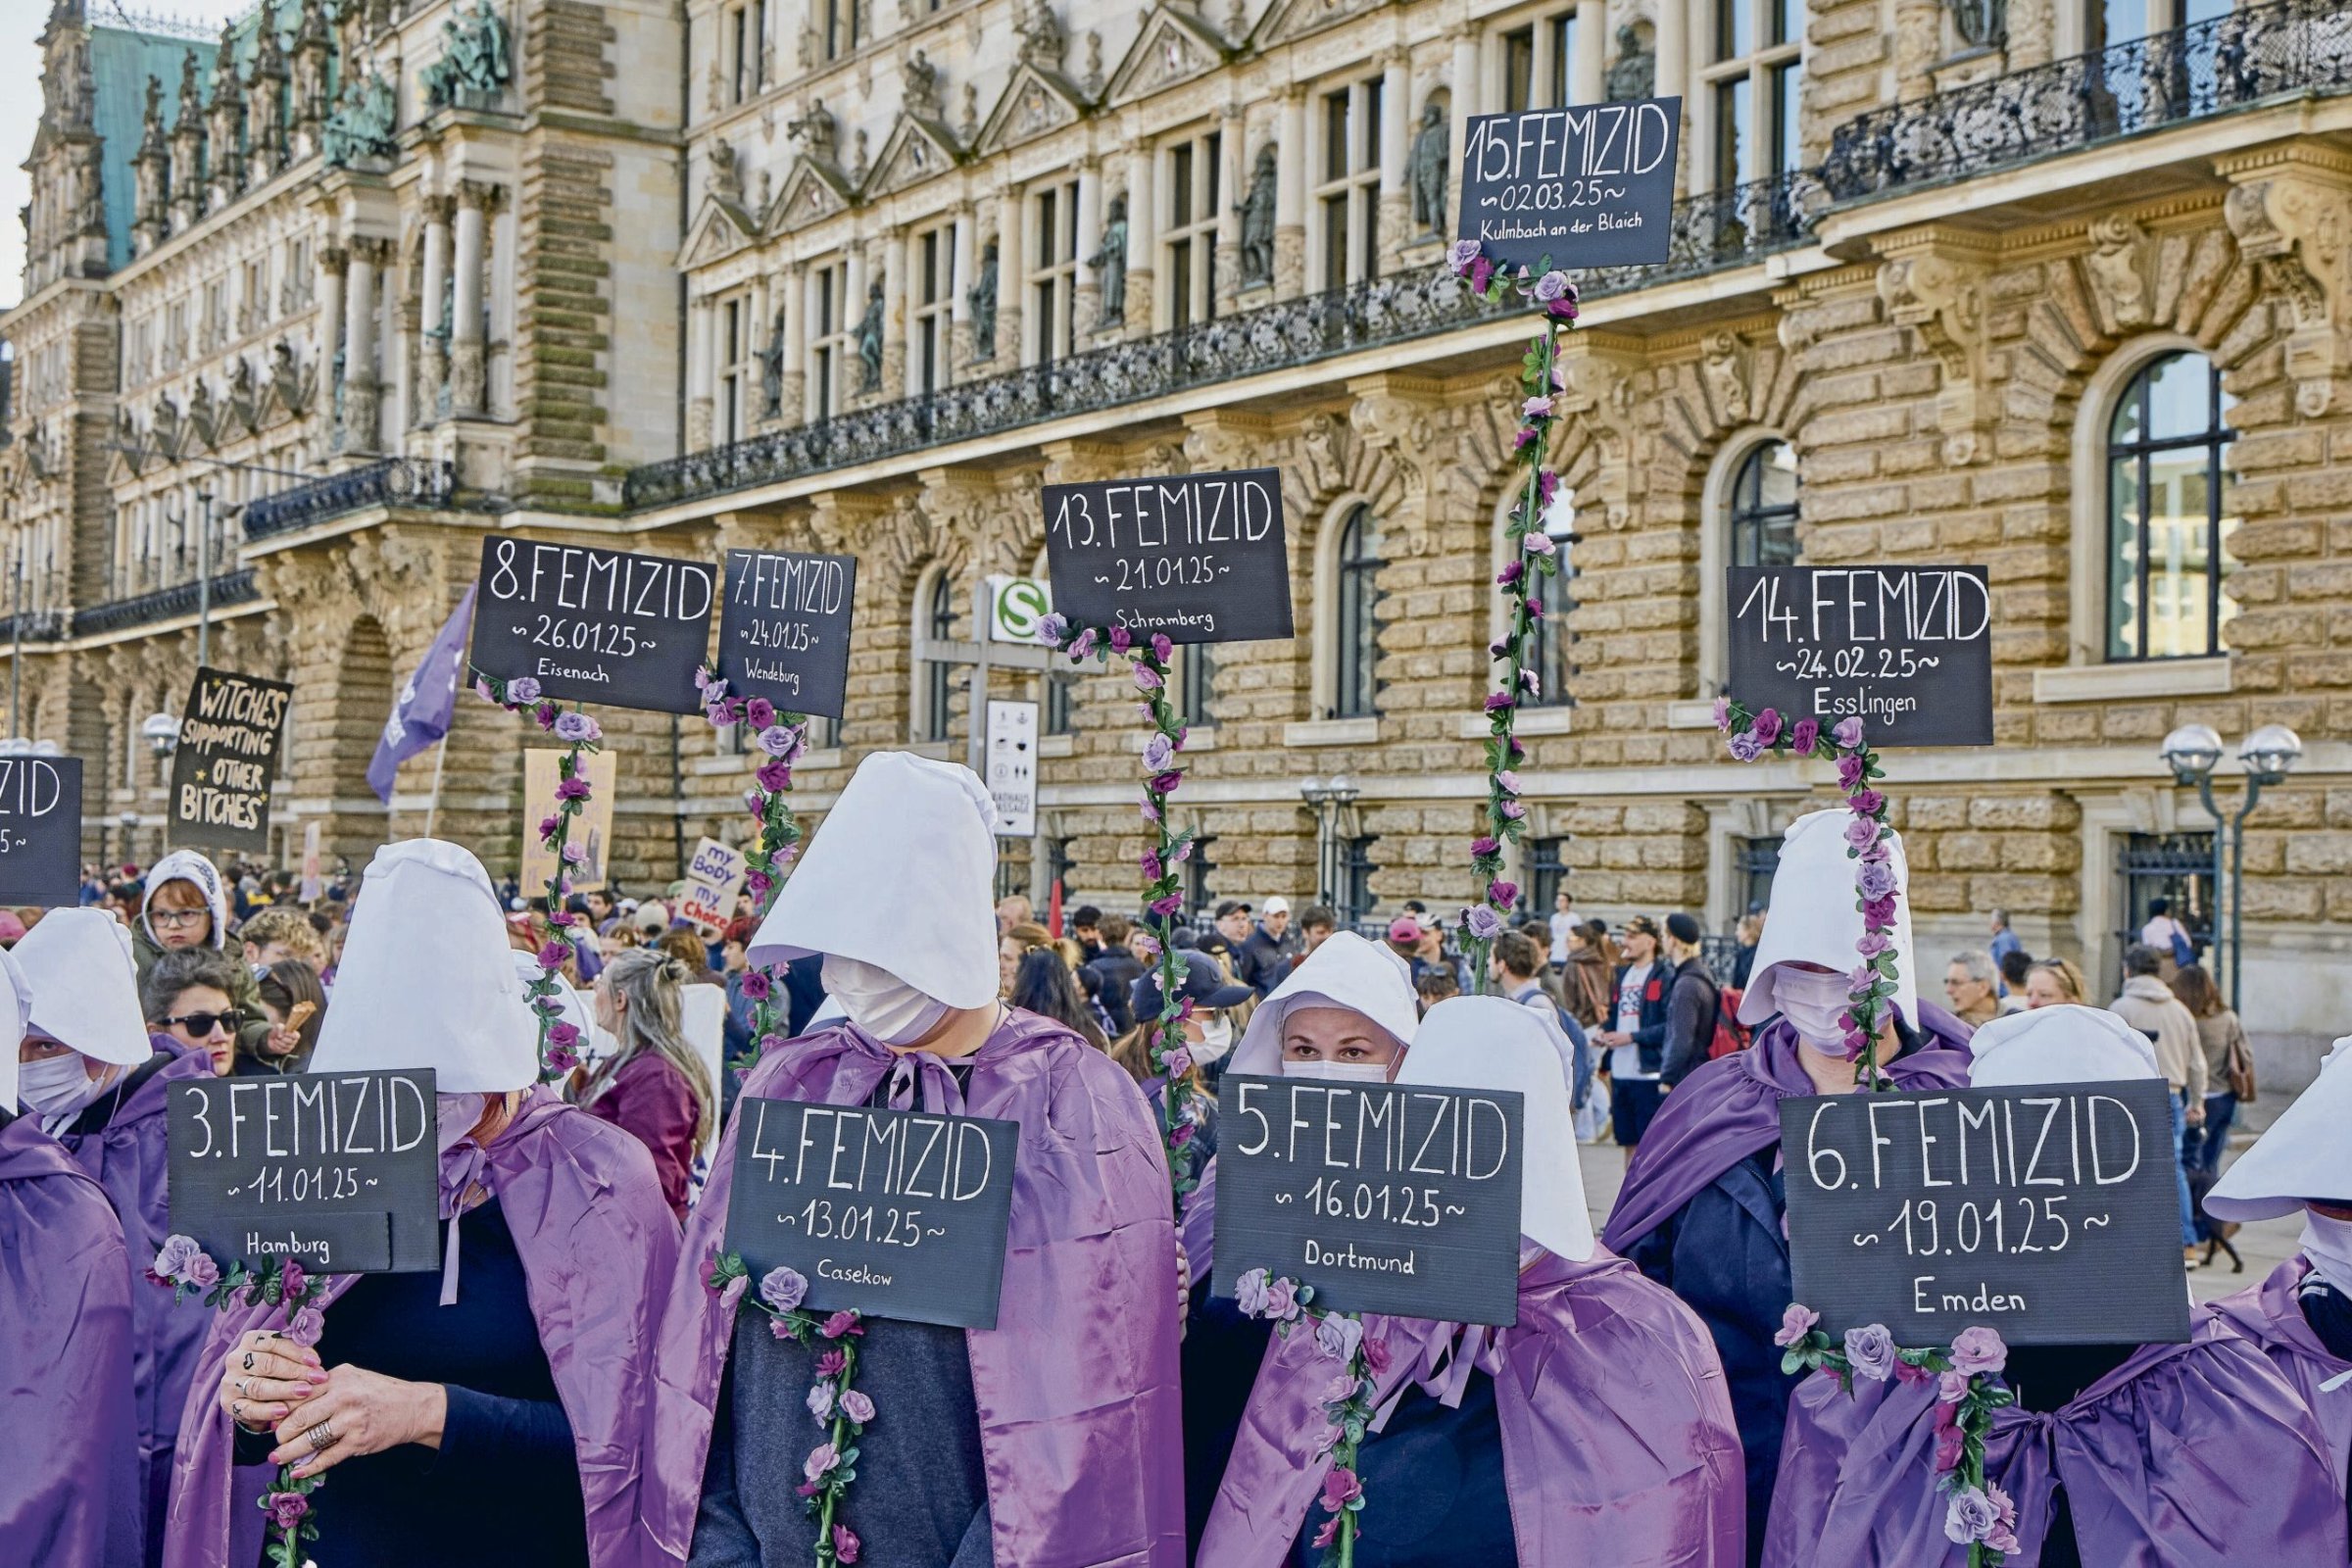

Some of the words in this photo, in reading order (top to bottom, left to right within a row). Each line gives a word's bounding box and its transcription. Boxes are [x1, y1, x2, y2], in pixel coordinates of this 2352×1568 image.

[1480, 219, 1546, 242] Kulmbach
[1550, 225, 1567, 236] an
[1570, 219, 1593, 234] der
[1597, 211, 1643, 231] Blaich
[1115, 609, 1215, 632] Schramberg
[537, 657, 610, 683] Eisenach
[745, 657, 800, 696] Wendeburg
[199, 679, 288, 730] WITCHES
[1814, 686, 1917, 726] Esslingen
[212, 758, 265, 791] OTHER
[179, 783, 263, 830] BITCHES
[707, 846, 735, 865] my
[696, 886, 720, 908] my
[683, 901, 728, 930] Choice
[247, 1231, 330, 1264] Hamburg
[1304, 1239, 1415, 1275] Dortmund
[816, 1258, 892, 1287] Casekow
[1914, 1276, 2026, 1313] Emden
